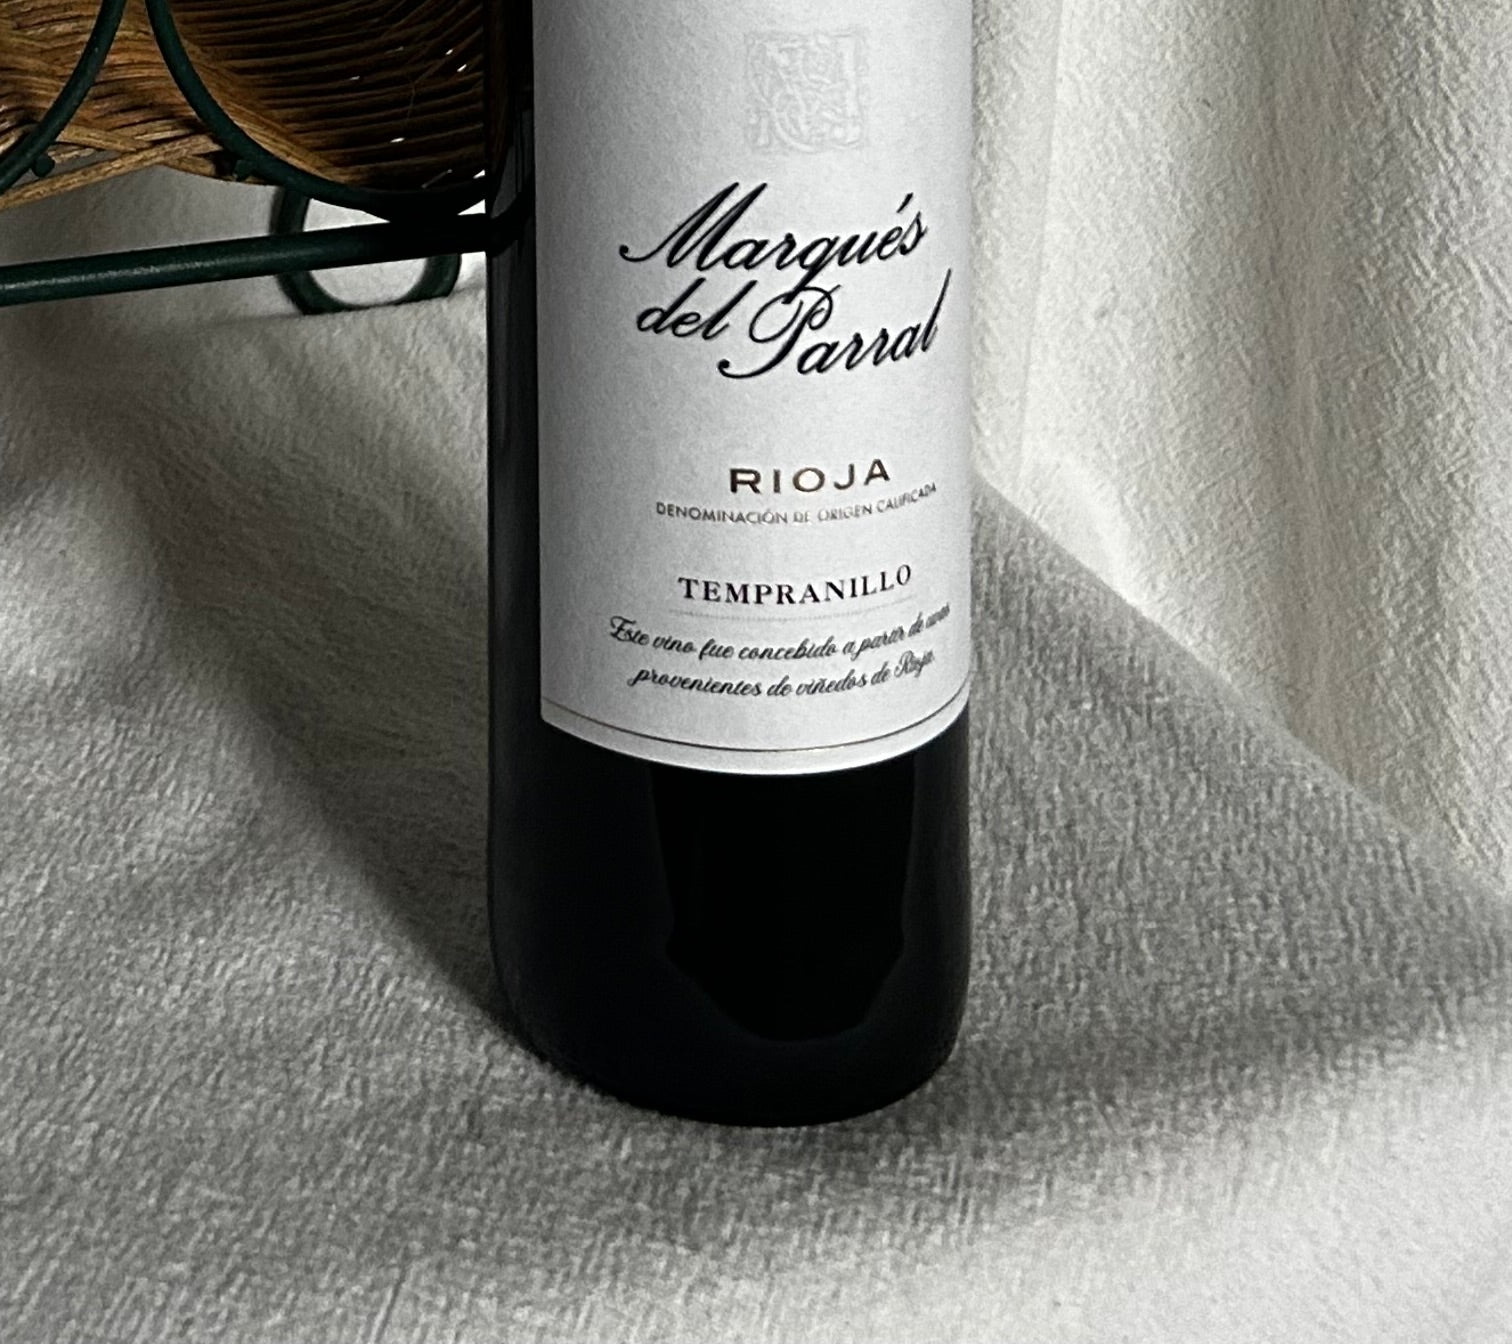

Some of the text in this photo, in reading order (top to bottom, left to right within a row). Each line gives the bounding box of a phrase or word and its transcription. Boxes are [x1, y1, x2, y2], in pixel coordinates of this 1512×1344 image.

[619, 182, 928, 305] Marqués
[637, 269, 952, 380] del Parral
[729, 458, 891, 495] RIOJA
[656, 482, 937, 524] DENOMINACIÓN DE ORIGEN CALIFICADA
[678, 564, 912, 605] TEMPRANILLO
[610, 615, 650, 646] Este
[652, 634, 696, 654] vino
[699, 638, 735, 660] fue
[738, 635, 837, 660] concebido
[841, 640, 856, 656] a
[626, 667, 763, 697] provenientes
[766, 674, 792, 697] de
[795, 668, 868, 696] viñedos
[870, 661, 891, 686] de
